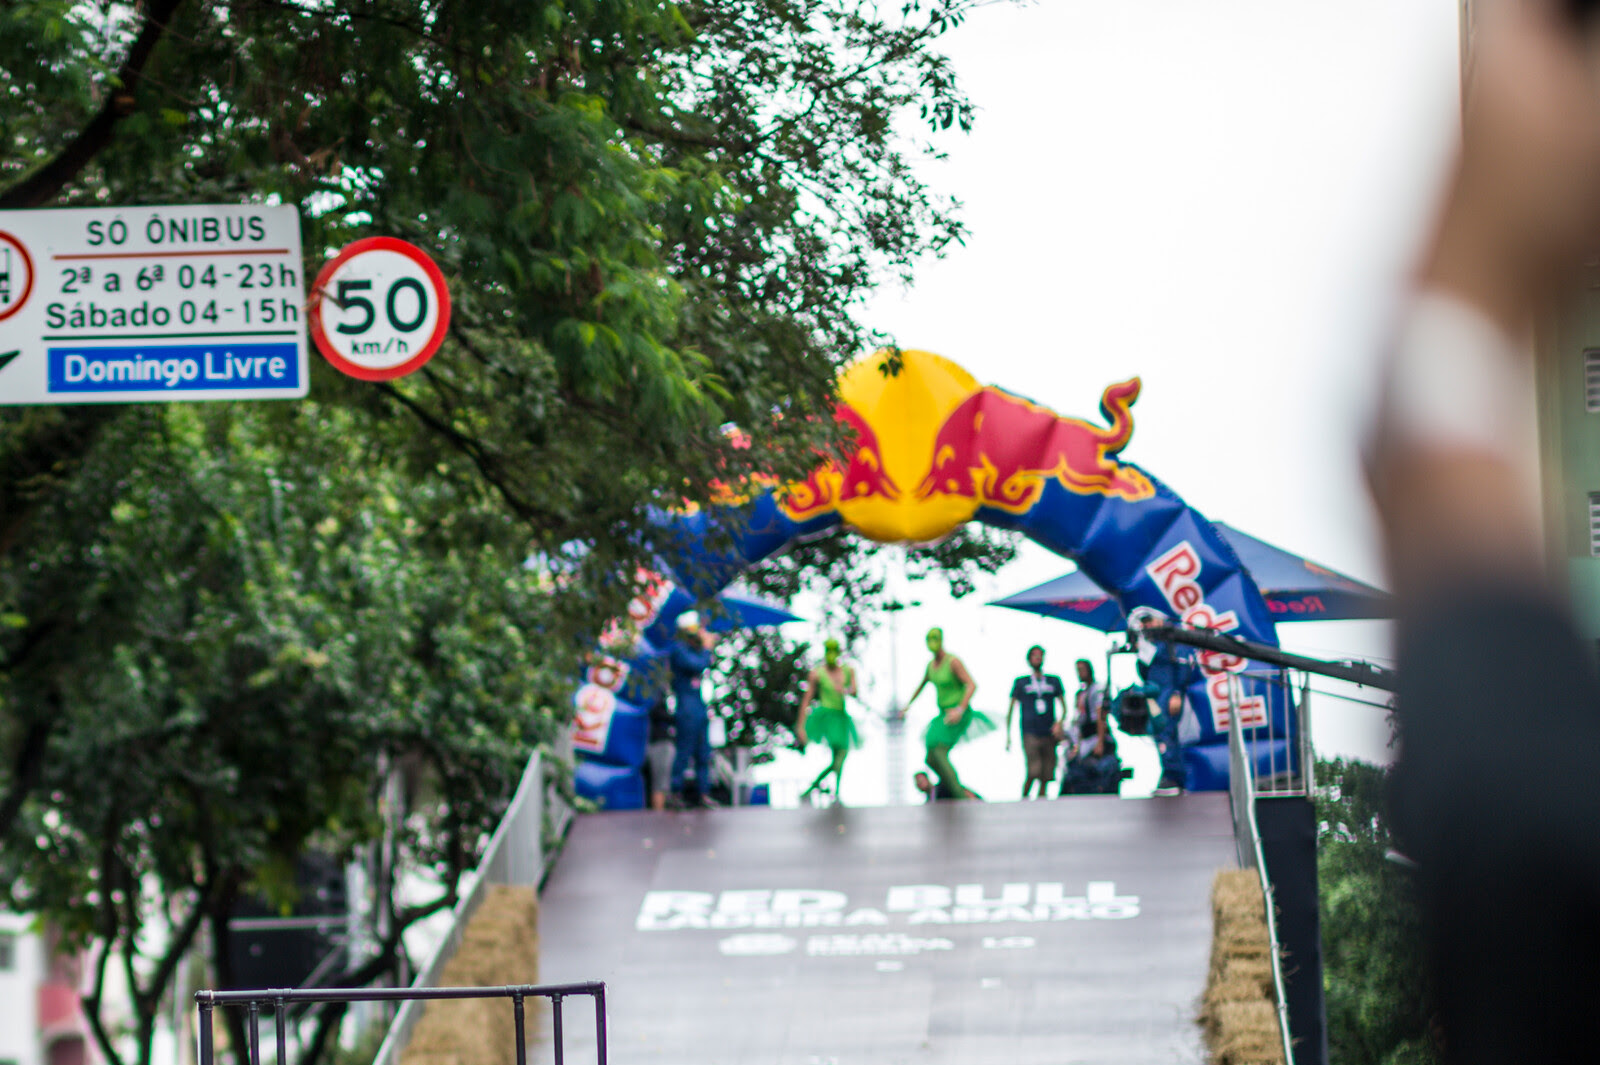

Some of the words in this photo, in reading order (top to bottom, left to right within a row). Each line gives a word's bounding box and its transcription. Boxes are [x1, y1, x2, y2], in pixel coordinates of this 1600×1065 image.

[86, 214, 127, 246] SÓ
[146, 213, 266, 244] ÔNIBUS
[61, 266, 92, 294] 2ª
[103, 272, 121, 293] a
[136, 264, 164, 291] 6ª
[46, 300, 170, 329] Sábado
[336, 276, 428, 335] 50
[351, 337, 409, 355] km/h
[64, 353, 199, 388] Domingo
[204, 351, 287, 381] Livre
[640, 889, 849, 915] RED
[886, 881, 1140, 911] BULL
